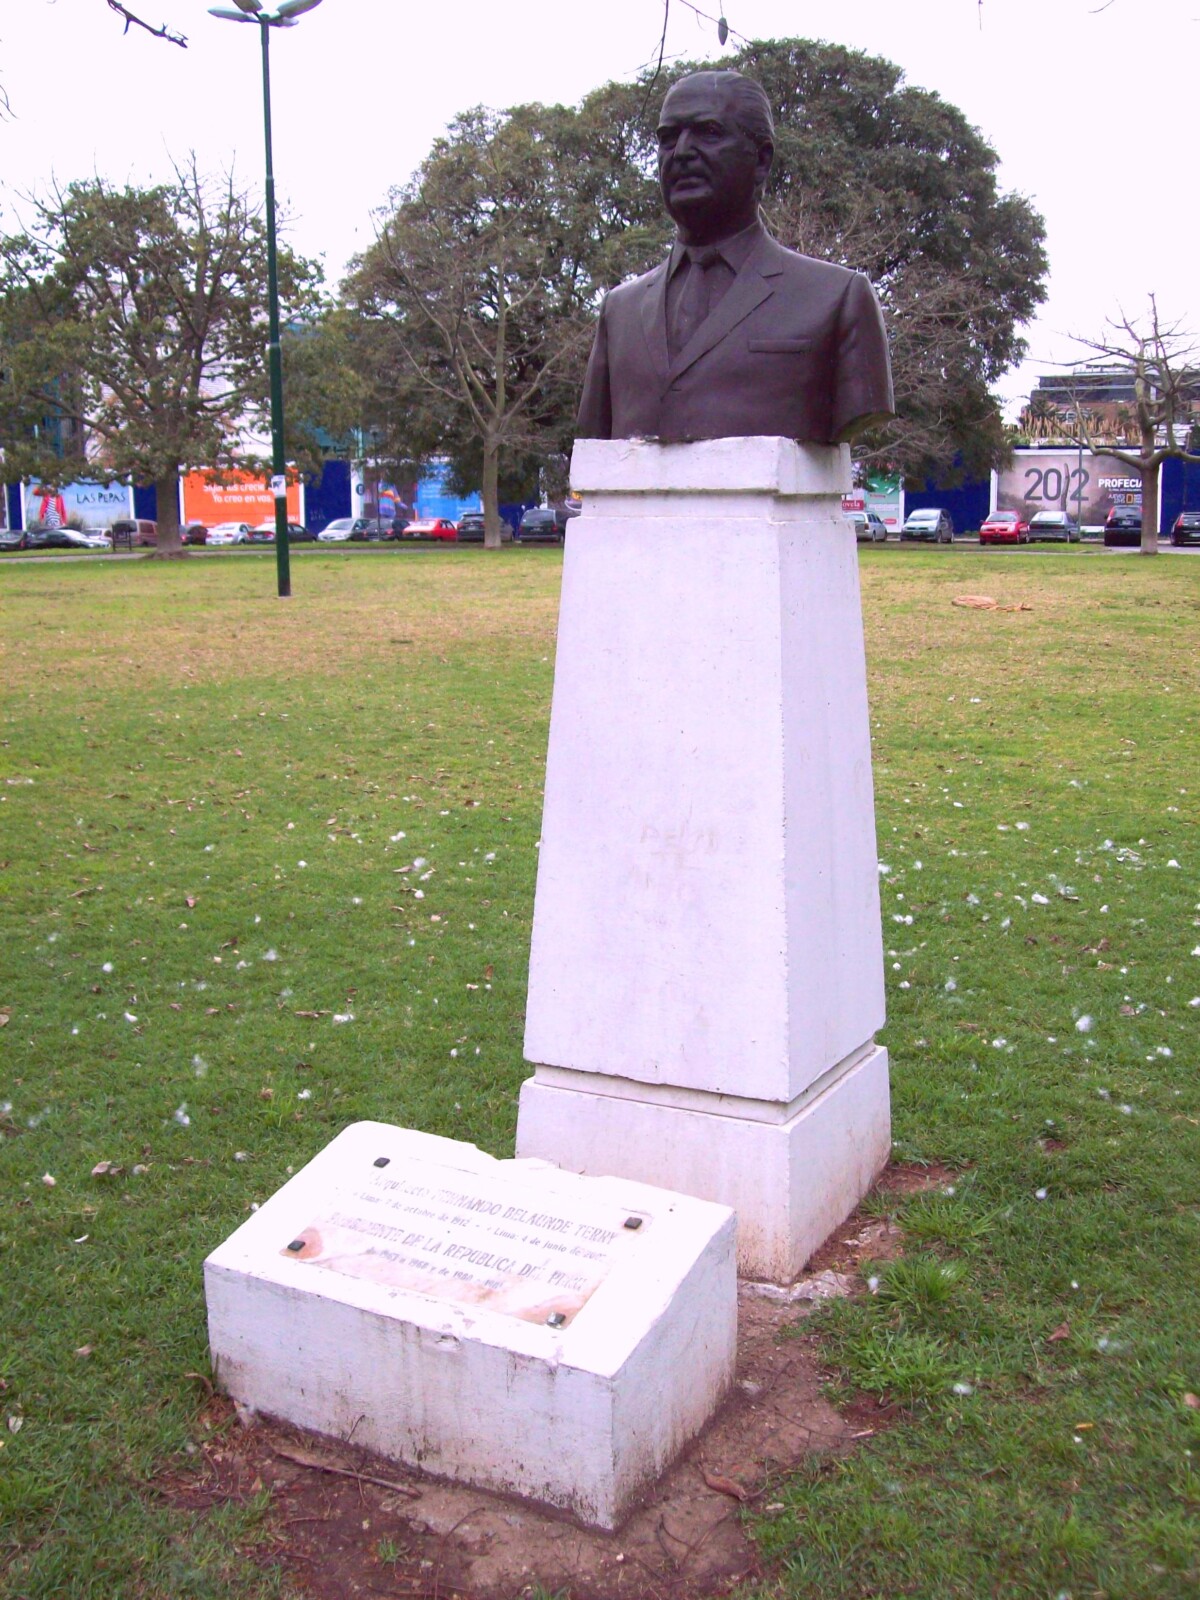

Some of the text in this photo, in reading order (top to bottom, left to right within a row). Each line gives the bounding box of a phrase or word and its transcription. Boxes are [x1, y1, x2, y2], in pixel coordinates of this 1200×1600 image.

[76, 492, 126, 504] LAS PEPAS
[213, 494, 223, 503] Yo
[224, 495, 243, 503] creo
[244, 495, 256, 503] en
[437, 1188, 503, 1217] FERNANDO
[502, 1206, 574, 1235] BELAUNDE
[573, 1223, 618, 1246] TERRY
[529, 1236, 541, 1246] de
[541, 1239, 568, 1253] junio
[401, 1231, 426, 1248] DE
[421, 1237, 443, 1255] LA
[517, 1262, 545, 1281] DEL
[438, 1267, 450, 1277] de
